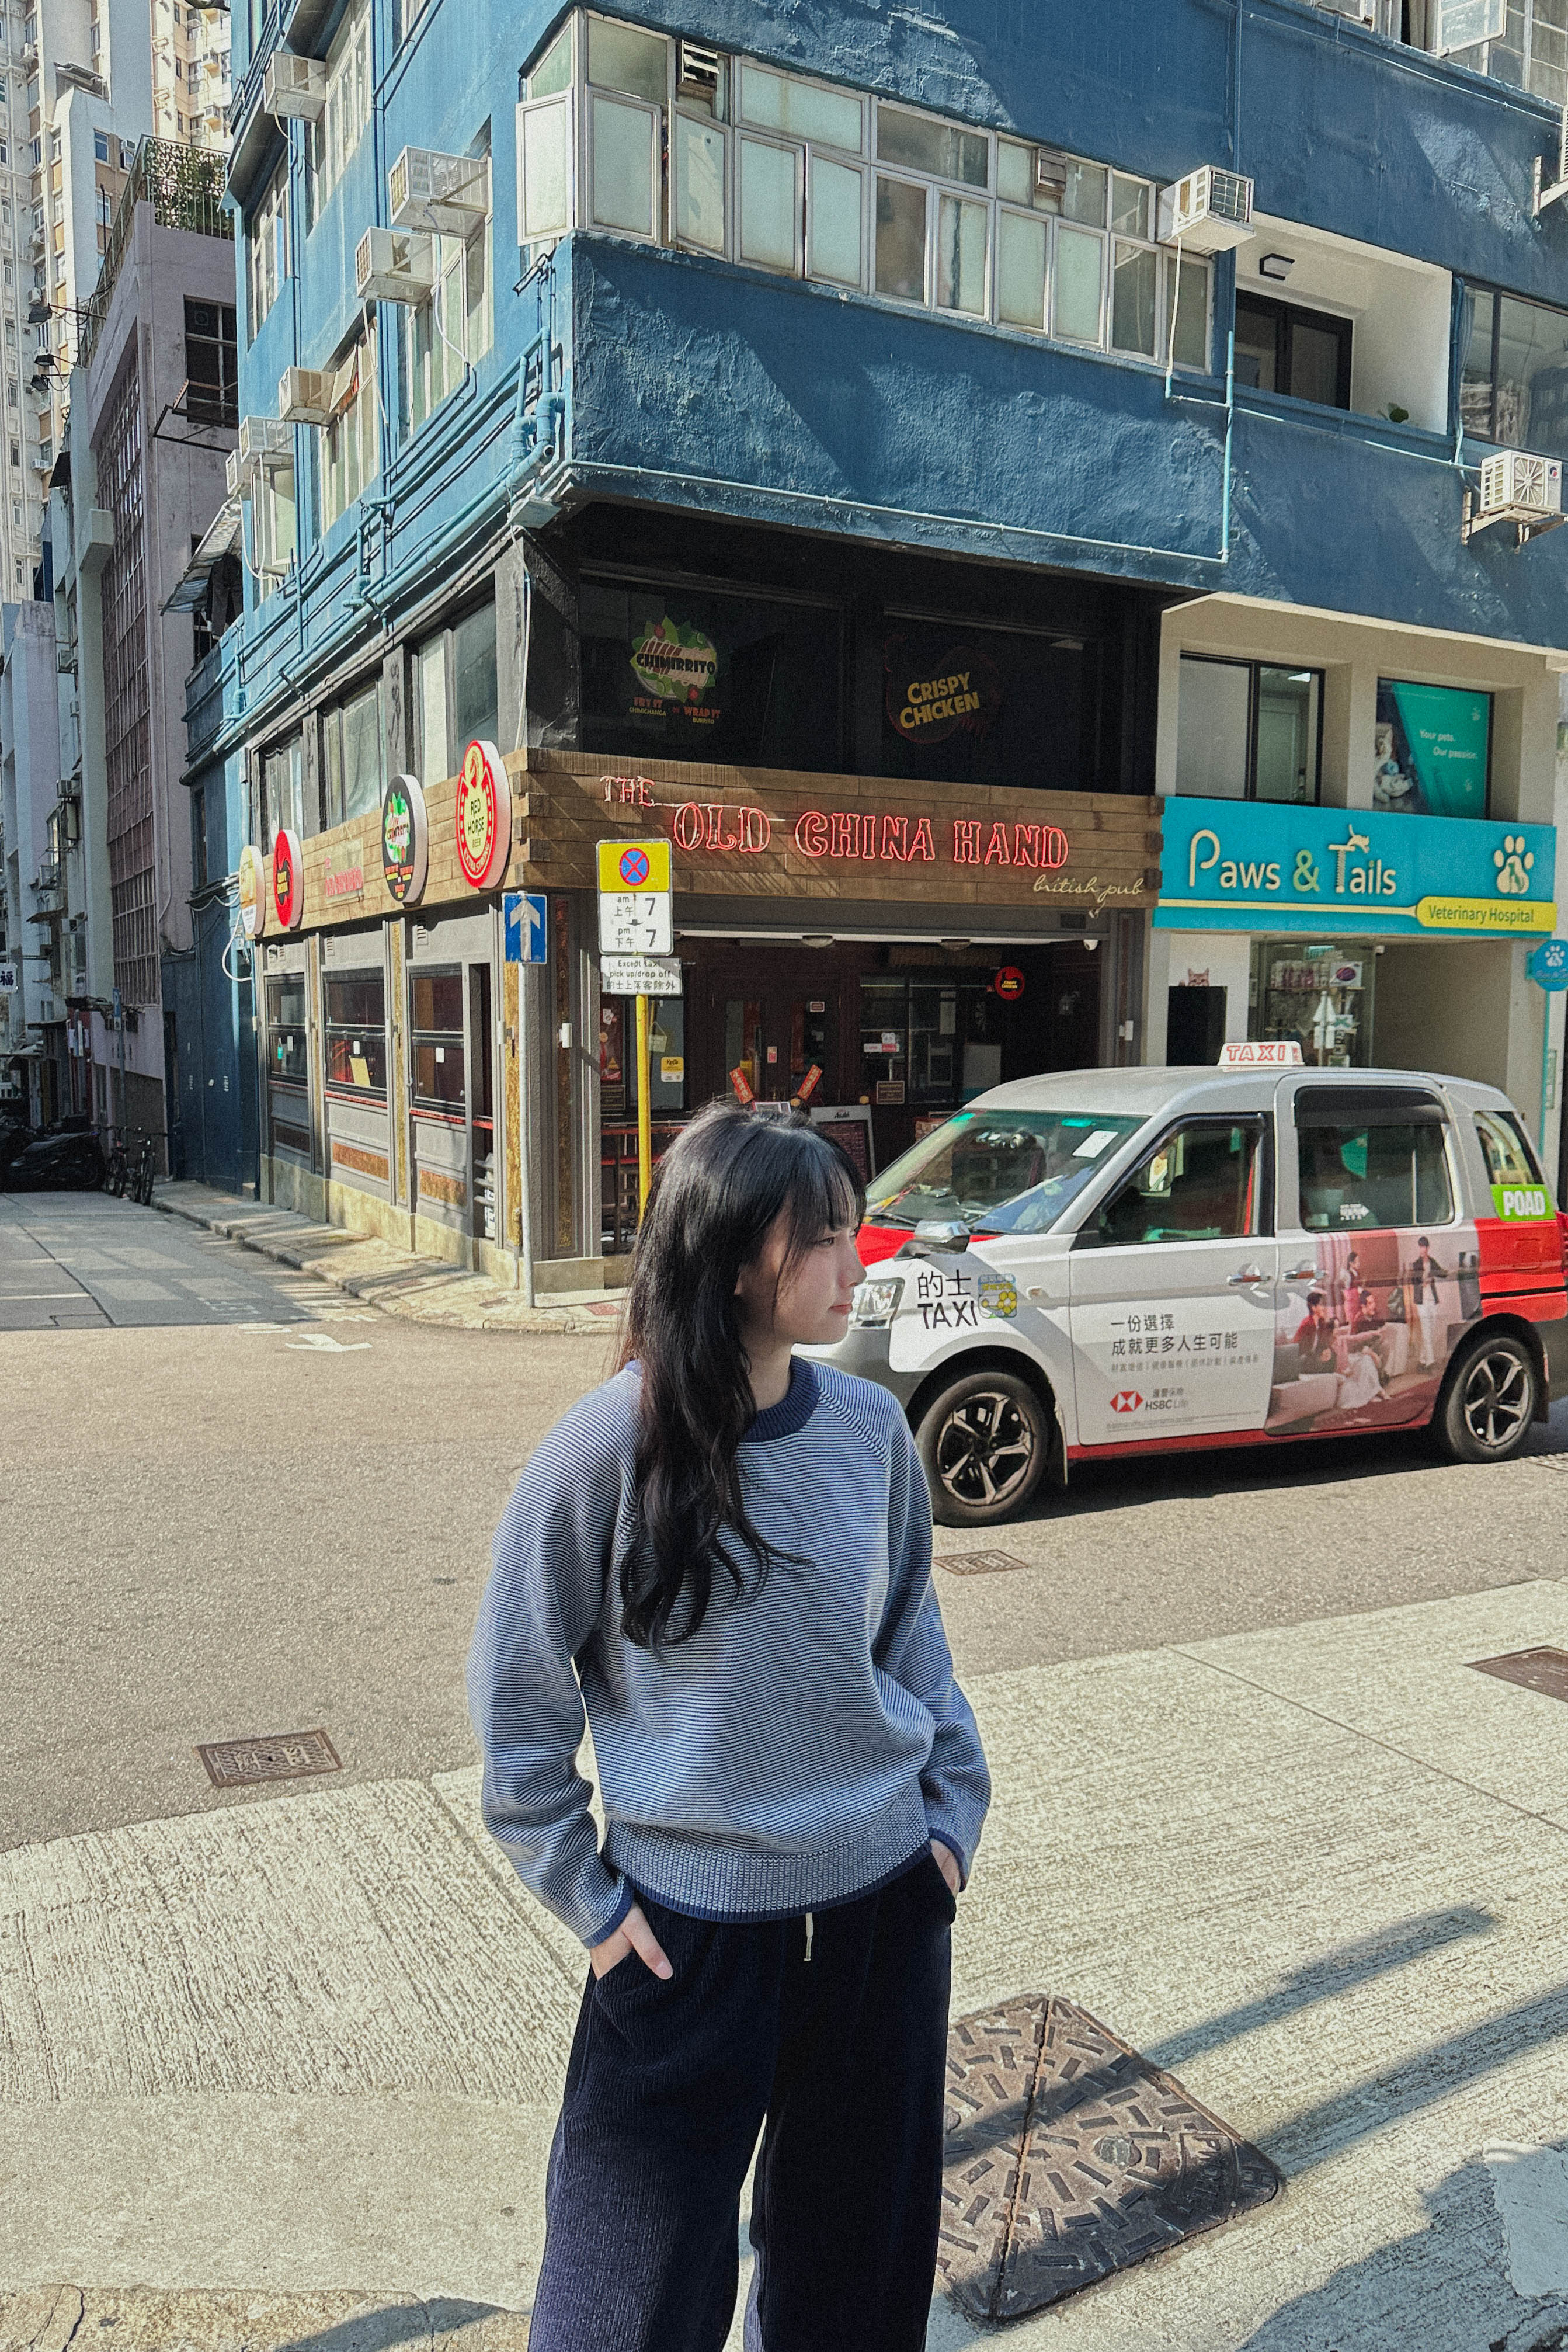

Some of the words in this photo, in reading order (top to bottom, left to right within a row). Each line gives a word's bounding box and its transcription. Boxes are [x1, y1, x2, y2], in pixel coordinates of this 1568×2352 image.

[637, 653, 716, 675] CHIMIRRITO
[907, 672, 970, 704] CRISPY
[900, 692, 980, 728] CHICKEN
[1420, 729, 1437, 741] Your
[1433, 746, 1447, 756] Our
[600, 776, 655, 807] THE
[471, 798, 481, 817] RED
[468, 817, 484, 836] HORSE
[673, 802, 770, 852] OLD
[795, 811, 935, 861] CHINA
[953, 820, 1069, 868] HAND
[1189, 829, 1281, 890] Paws
[1293, 849, 1320, 892] &
[1328, 844, 1396, 895] Tails
[1033, 874, 1098, 893] british
[1097, 878, 1144, 903] pub
[614, 906, 634, 916] 上午
[645, 898, 656, 916] 7
[1429, 905, 1487, 925] Veterinary
[1489, 908, 1534, 926] Hospital
[615, 937, 635, 948] 下午
[646, 929, 656, 947] 7
[618, 960, 641, 969] Except
[626, 971, 655, 979] up/drop
[607, 979, 675, 992] 的士上落客除外
[1226, 1045, 1285, 1061] TAXI
[1503, 1190, 1546, 1216] POAD
[917, 1269, 972, 1298] 的士
[917, 1300, 978, 1329] TAXI
[1111, 1314, 1174, 1332] 一份選擇
[1112, 1332, 1237, 1356] 成就更多人生可能
[1145, 1399, 1173, 1410] HSBC
